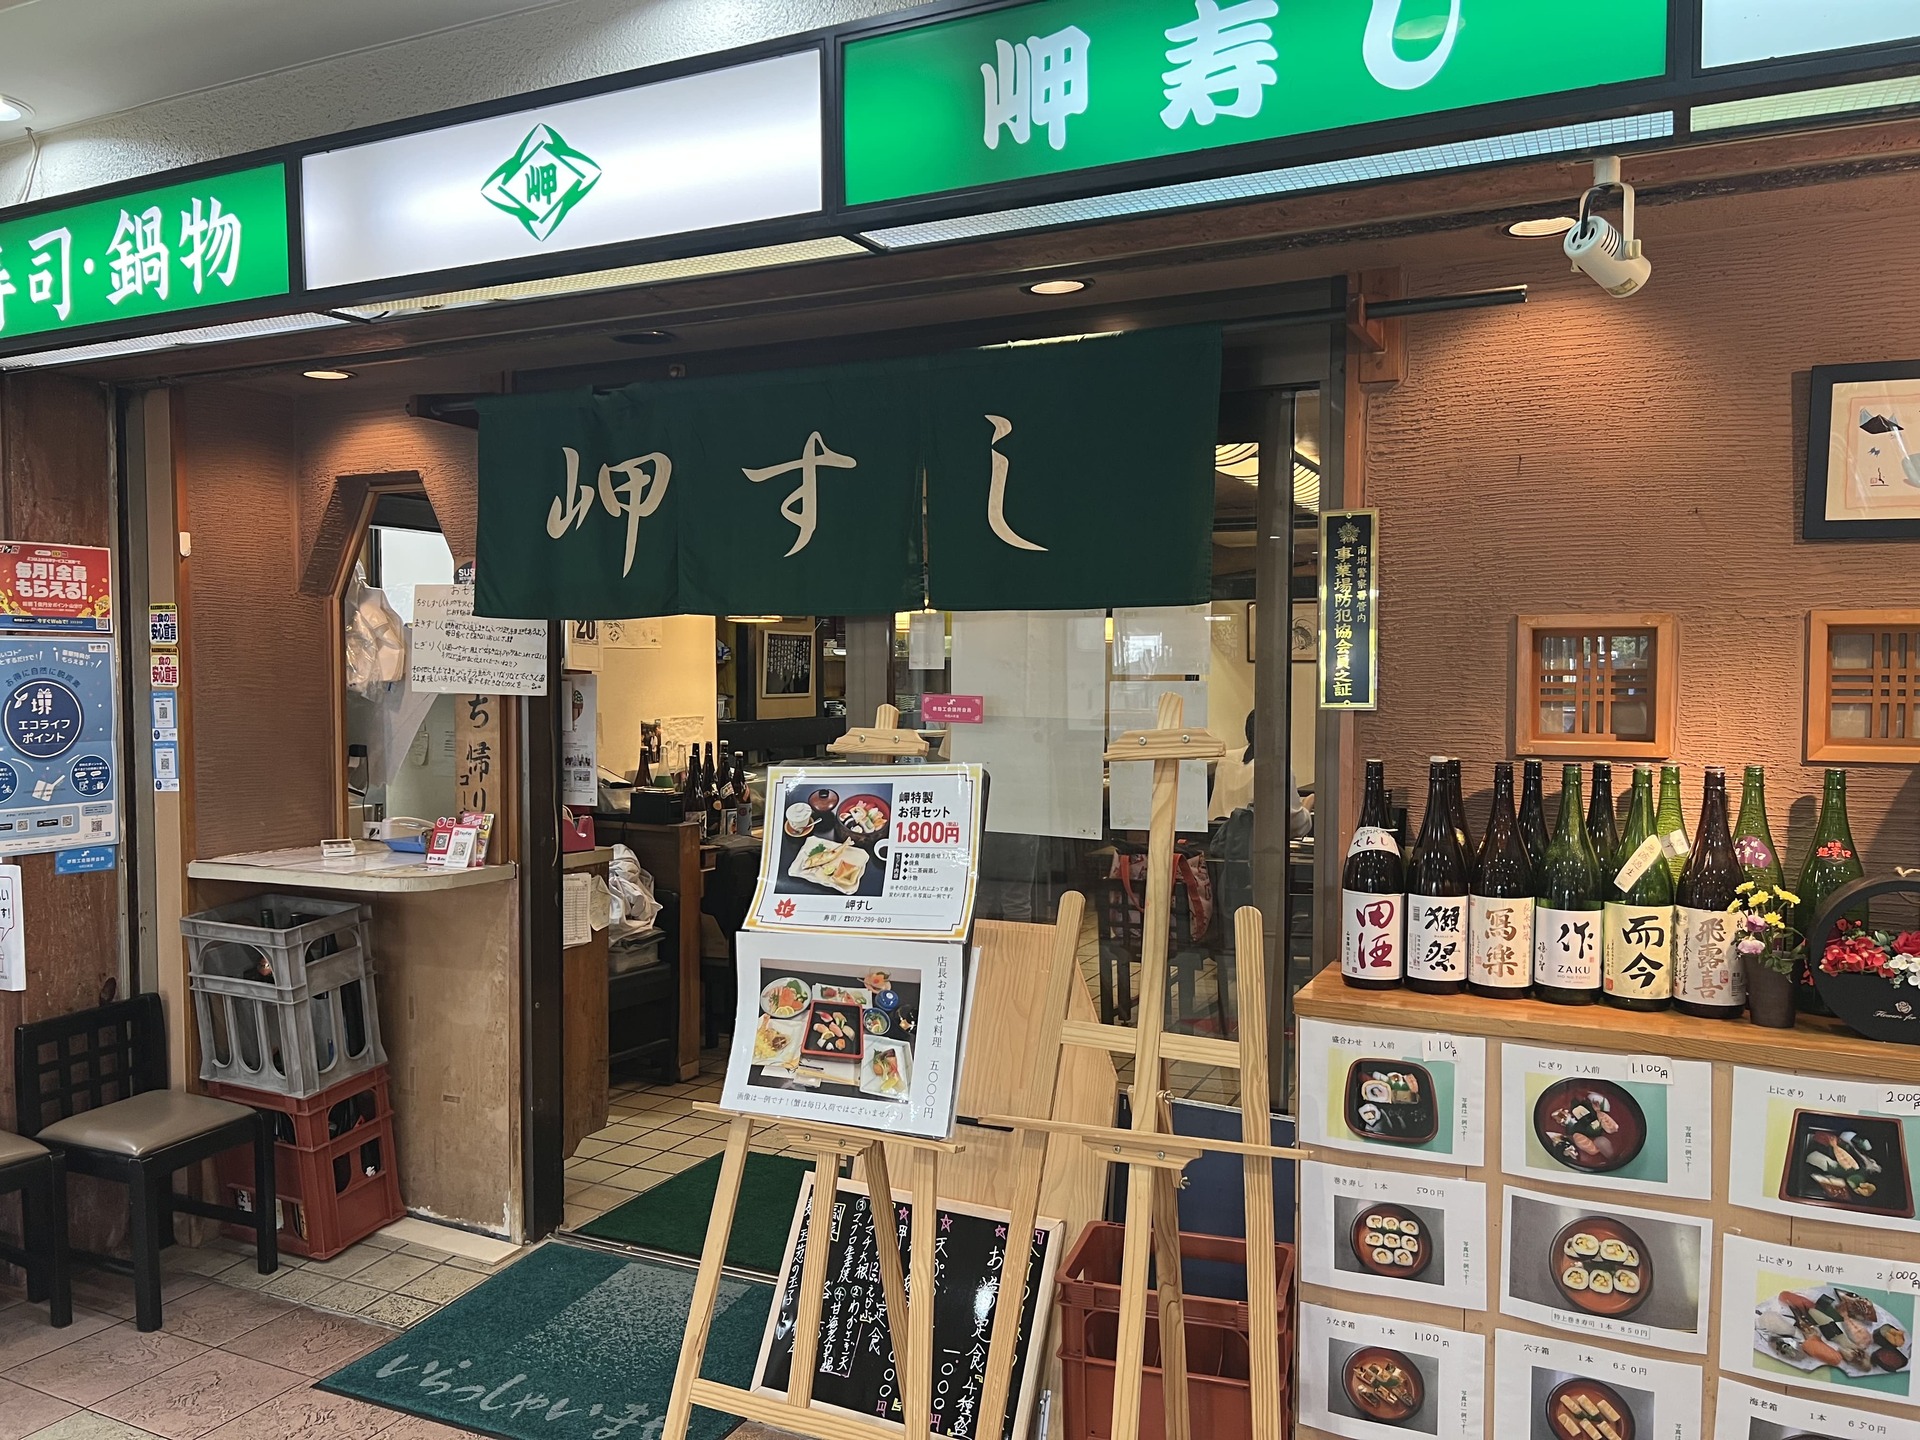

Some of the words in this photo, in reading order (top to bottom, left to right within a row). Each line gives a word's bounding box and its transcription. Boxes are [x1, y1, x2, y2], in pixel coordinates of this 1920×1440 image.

[525, 163, 556, 204] 岬
[0, 196, 241, 332] 司・鍋物
[546, 414, 1050, 578] 岬すし
[15, 579, 88, 600] もらえる!
[1356, 544, 1368, 624] 南堺警察署管内
[151, 623, 177, 640] 安心宣言
[1333, 546, 1355, 698] 事業場防犯協会員之証
[152, 666, 178, 683] 安心宣言
[18, 719, 71, 730] エコライフ
[22, 732, 66, 744] ポイント
[898, 791, 934, 804] 岬特製
[897, 806, 951, 818] お得セット
[895, 821, 960, 844] 1,800円
[845, 900, 873, 911] 岬すし
[1356, 900, 1395, 970] 田酒
[1424, 906, 1461, 973] 獺祭
[1556, 921, 1594, 960] 作
[1621, 915, 1665, 989] 而今
[1694, 917, 1728, 999] 飛露喜
[1557, 965, 1591, 975] ZAKU
[931, 956, 948, 1048] 店長おまかせ料理
[1332, 1035, 1363, 1047] 盛合わせ
[1373, 1041, 1395, 1050] 1人前
[1538, 1060, 1563, 1071] にぎり
[1575, 1065, 1600, 1074] 1人前
[1766, 1085, 1804, 1098] 上にぎり
[1818, 1093, 1847, 1104] 1人前
[1333, 1177, 1365, 1188] 巻き寿し
[1373, 1182, 1388, 1190] 1本
[1756, 1253, 1794, 1267] 上にぎり
[1807, 1263, 1845, 1274] 1人前半
[1325, 1316, 1356, 1330] うなぎ箱
[1381, 1327, 1396, 1336] 1本
[1553, 1312, 1596, 1328] 特上巻き寿司
[1620, 1326, 1649, 1338] 850円
[1523, 1343, 1550, 1355] 穴子箱
[1578, 1354, 1594, 1364] 1本
[1612, 1362, 1648, 1376] 650円
[1809, 1412, 1828, 1422] 1本
